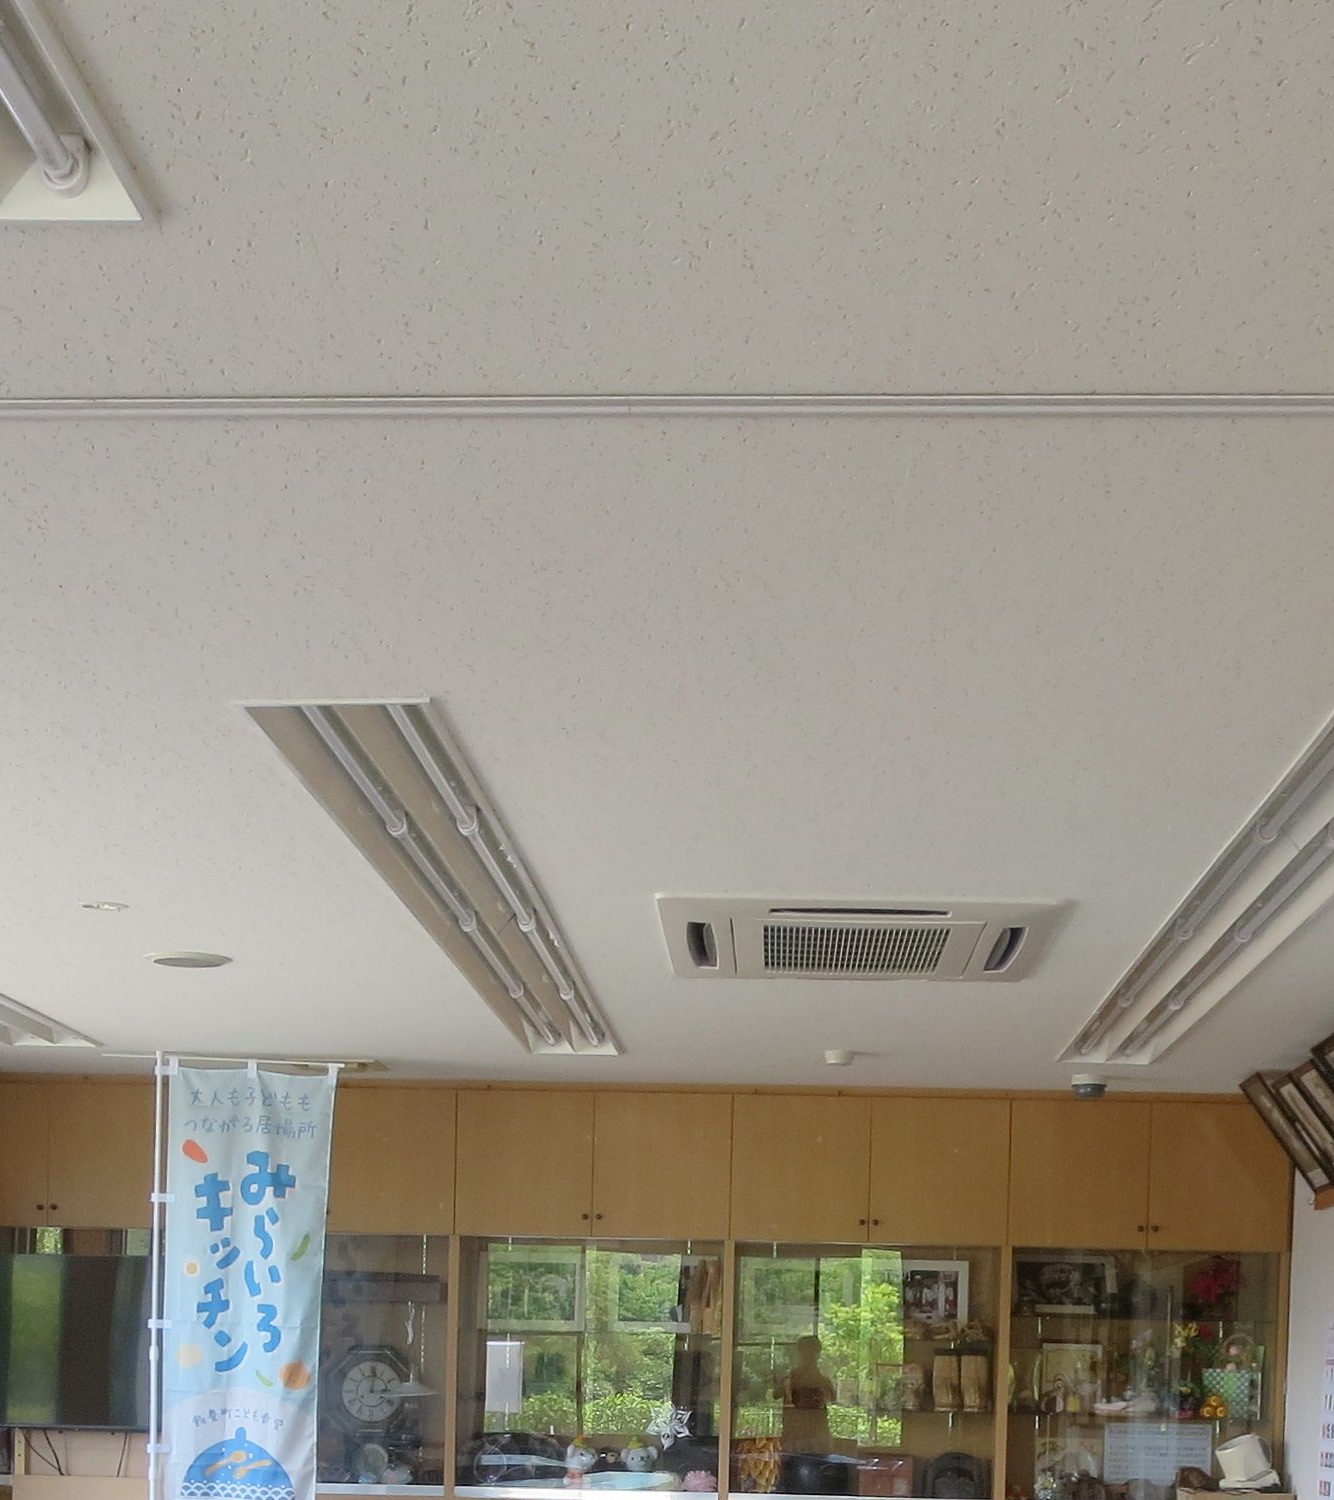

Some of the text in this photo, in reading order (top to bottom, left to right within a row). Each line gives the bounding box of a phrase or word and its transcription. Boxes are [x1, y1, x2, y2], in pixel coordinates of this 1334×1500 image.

[190, 1086, 312, 1112] 大人も子どもも
[194, 1172, 249, 1373] キッチン
[240, 1150, 297, 1354] みらいろ
